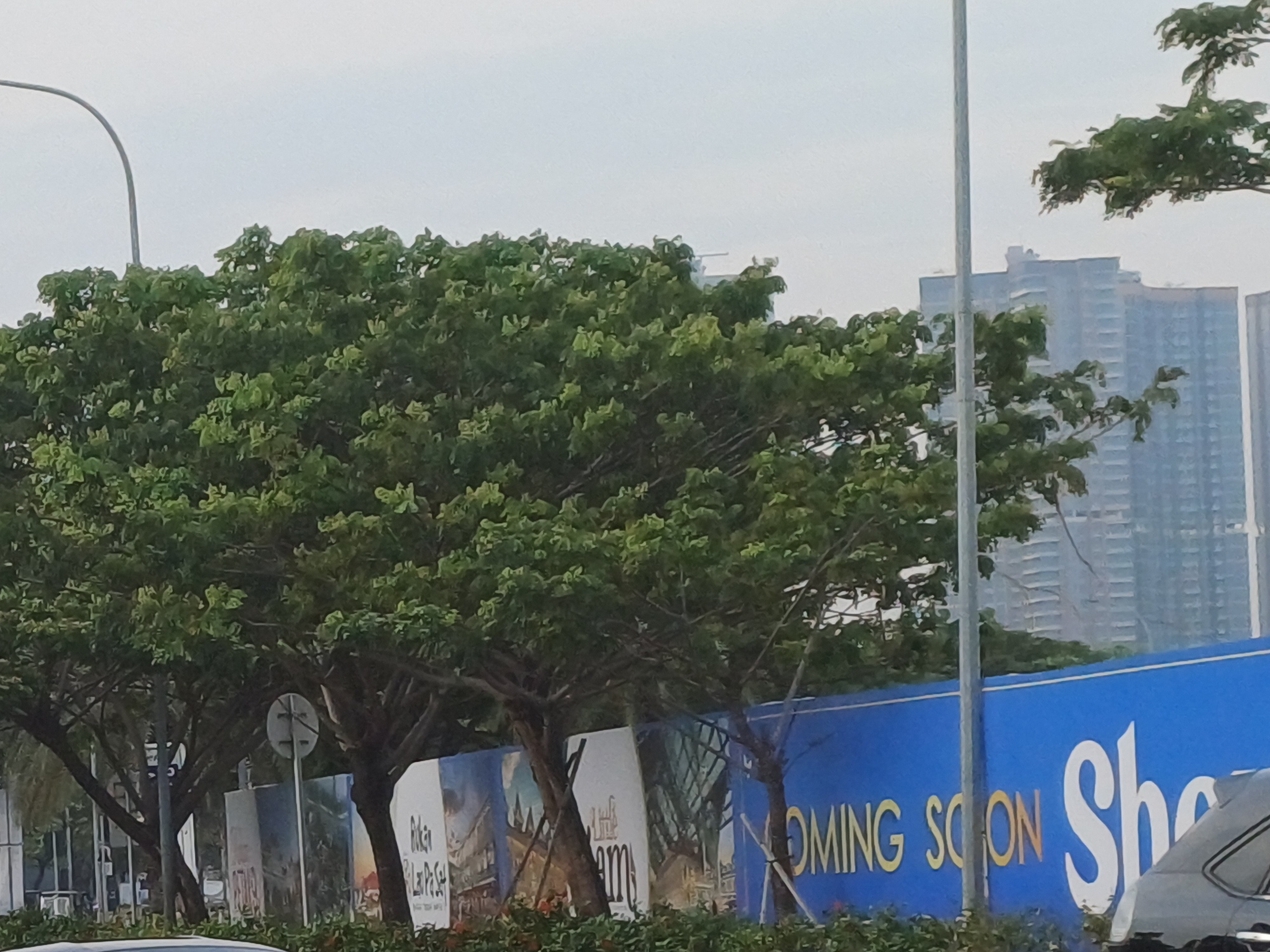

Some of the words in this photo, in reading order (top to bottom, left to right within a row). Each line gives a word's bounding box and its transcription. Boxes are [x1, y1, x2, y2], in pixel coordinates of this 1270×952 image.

[765, 799, 904, 876] OMING
[926, 789, 1043, 867] SOON
[1063, 720, 1256, 914] Sh
